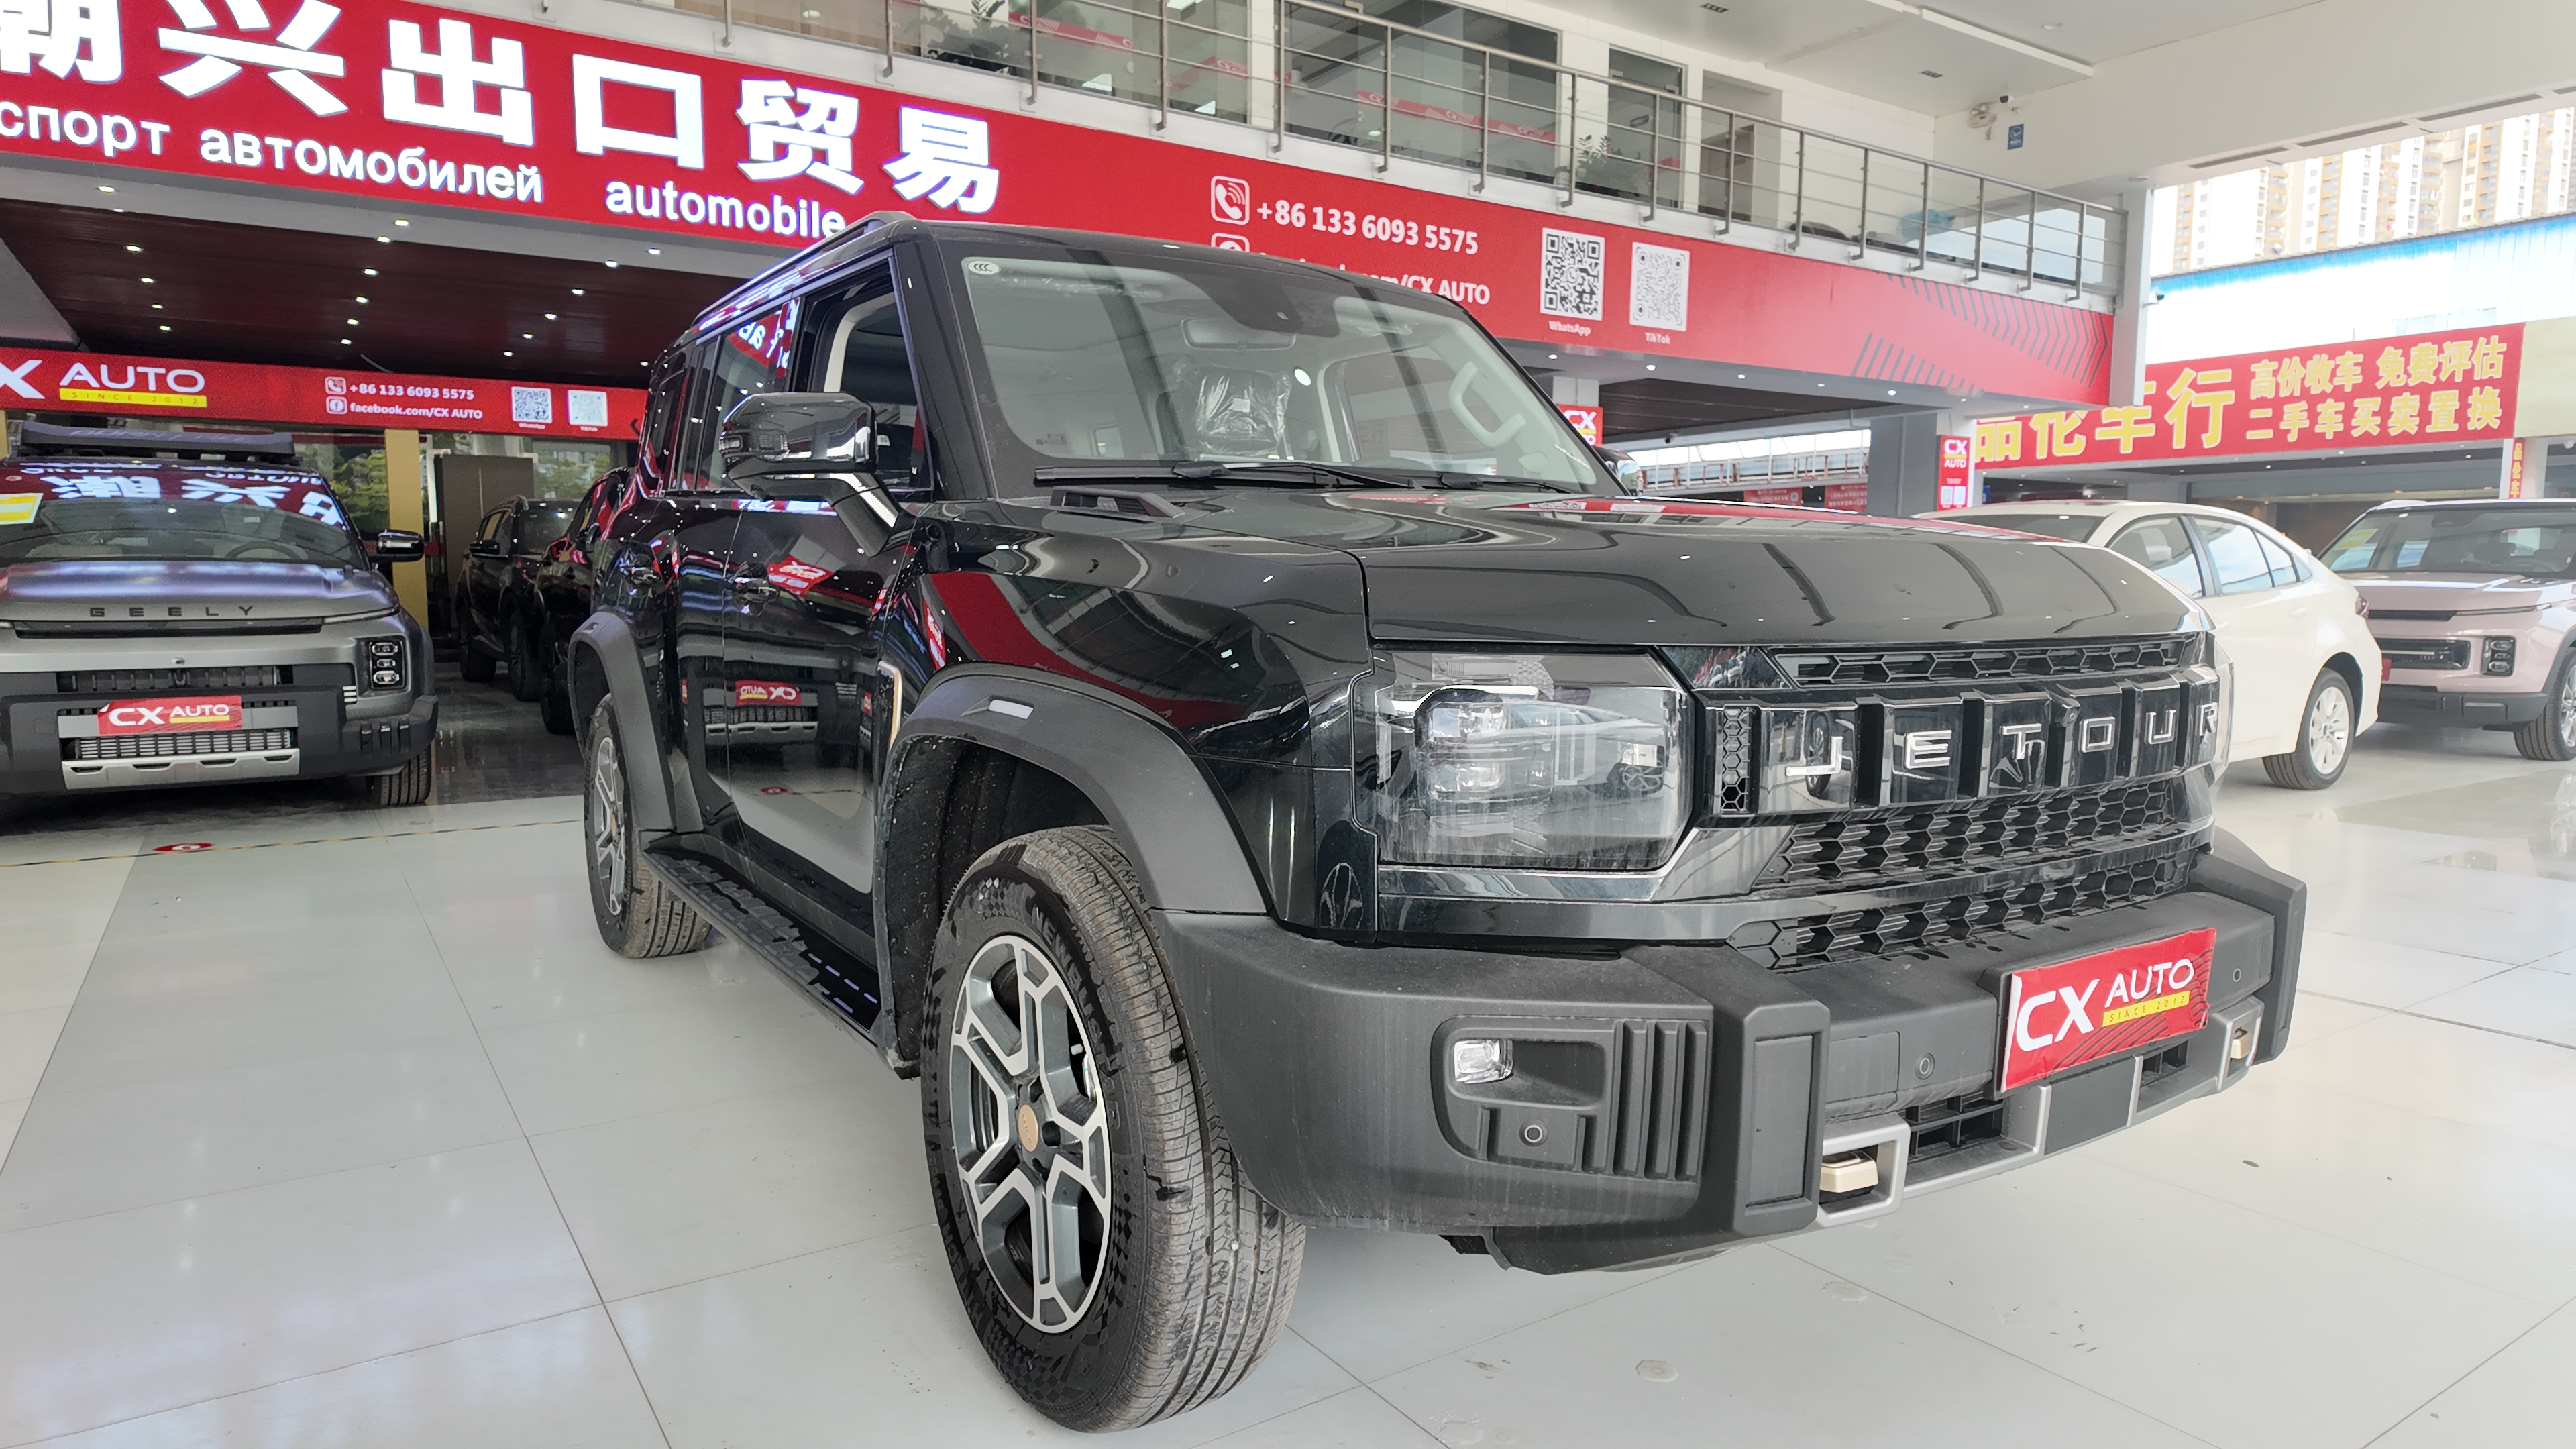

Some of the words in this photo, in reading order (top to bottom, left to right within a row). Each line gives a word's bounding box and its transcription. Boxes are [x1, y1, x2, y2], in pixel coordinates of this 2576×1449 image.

[200, 127, 543, 203] автомобилей
[606, 180, 846, 239] automobile
[1256, 199, 1306, 229] +86
[1312, 206, 1356, 237] 133
[1362, 214, 1419, 246] 6093
[1424, 225, 1479, 254] 5575
[1437, 278, 1491, 305] AUTO
[1548, 320, 1592, 337] WhatsApp
[1644, 331, 1671, 345] TikTok
[59, 362, 205, 394] AUTO
[2249, 350, 2365, 400] 高价收车
[2375, 335, 2508, 390] 免费评估
[72, 391, 133, 402] SINCE
[152, 394, 199, 405] 2012
[350, 384, 377, 394] +86
[380, 384, 405, 396] 133
[407, 387, 439, 399] 6093
[443, 388, 475, 400] 5575
[350, 402, 450, 419] facebook.com/CX
[452, 408, 483, 420] AUTO
[2245, 386, 2503, 443] 二手车买卖置换
[1944, 439, 1968, 455] CX
[1944, 459, 1967, 468] AUTO
[89, 604, 254, 619] GEELY
[108, 706, 166, 727] CX
[169, 704, 230, 718] AUTO
[1785, 700, 2218, 777] JETOUR
[2015, 978, 2100, 1052] CX
[2104, 958, 2195, 1008] AUTO
[2109, 1004, 2147, 1023] SINCE
[2155, 994, 2187, 1013] 2012
